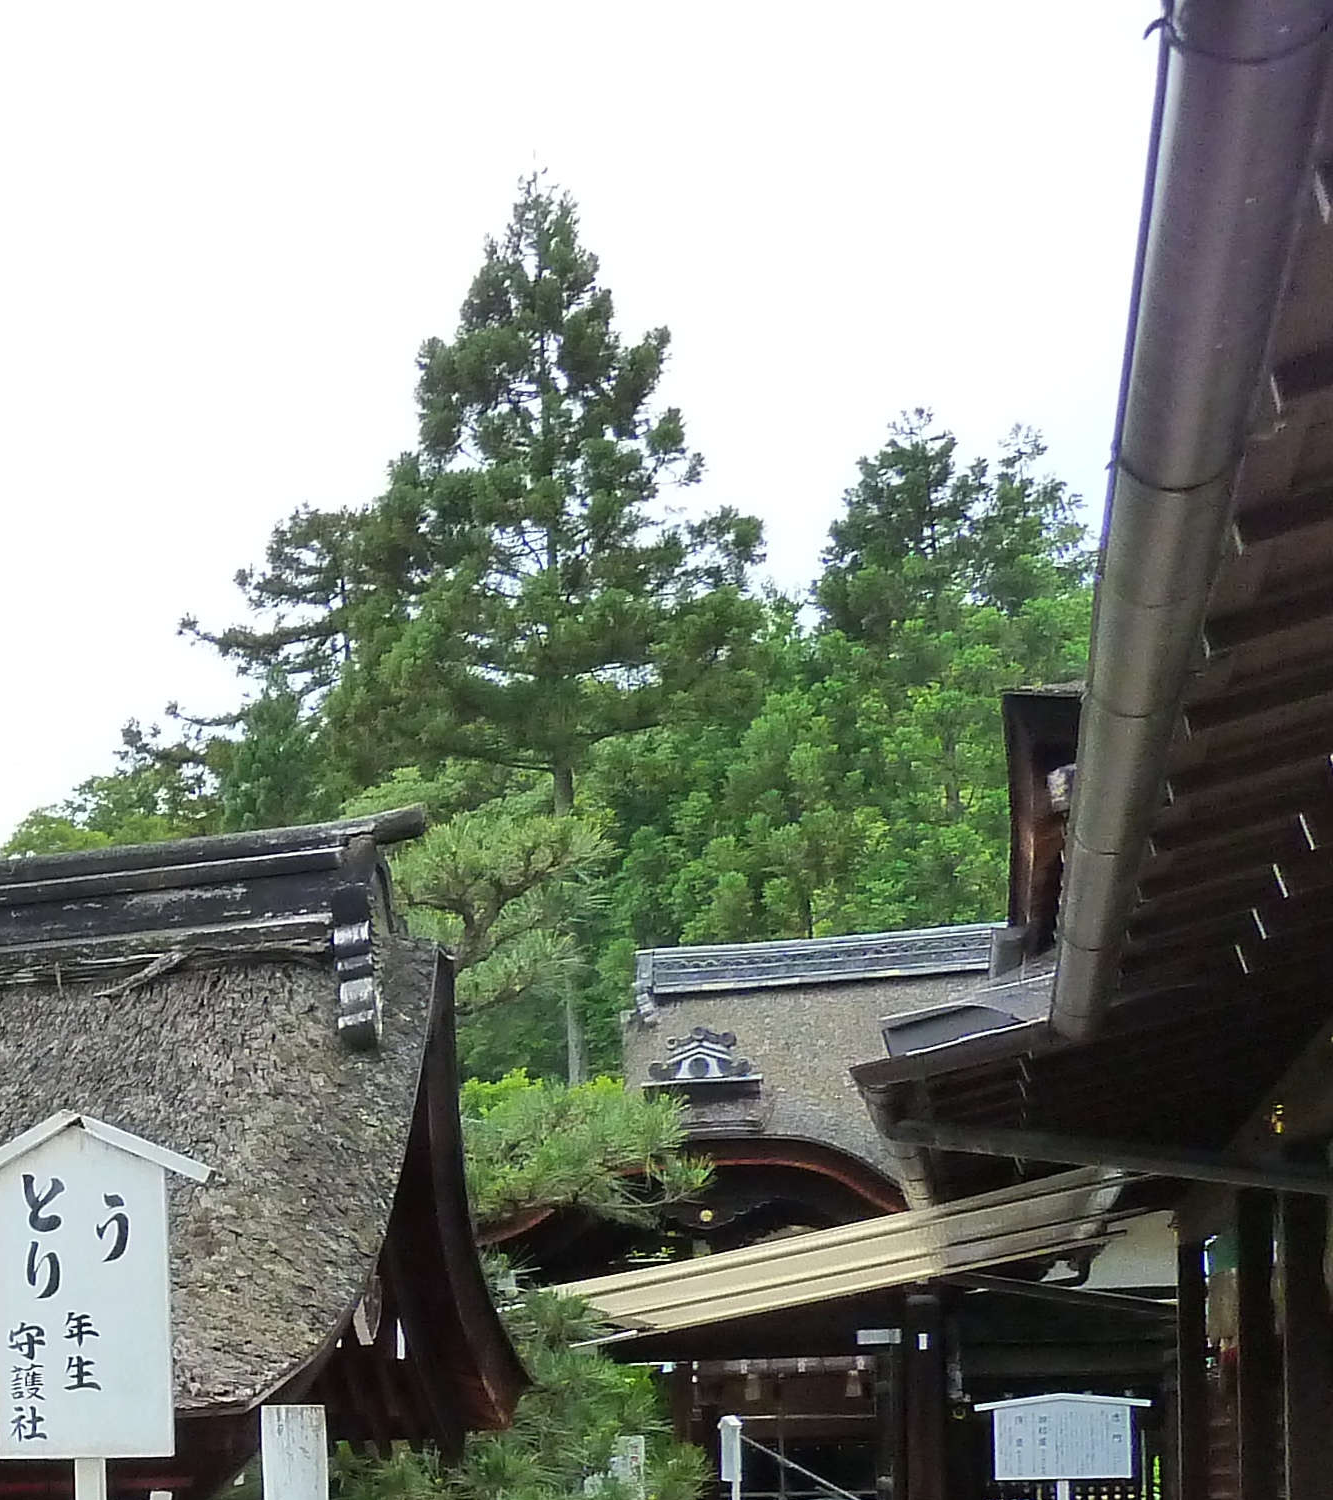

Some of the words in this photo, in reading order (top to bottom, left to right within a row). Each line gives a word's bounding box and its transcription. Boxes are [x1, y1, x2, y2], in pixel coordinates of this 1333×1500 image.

[21, 1173, 66, 1300] とり
[95, 1192, 130, 1263] う
[7, 1321, 49, 1443] 守護社
[63, 1311, 102, 1392] 年生
